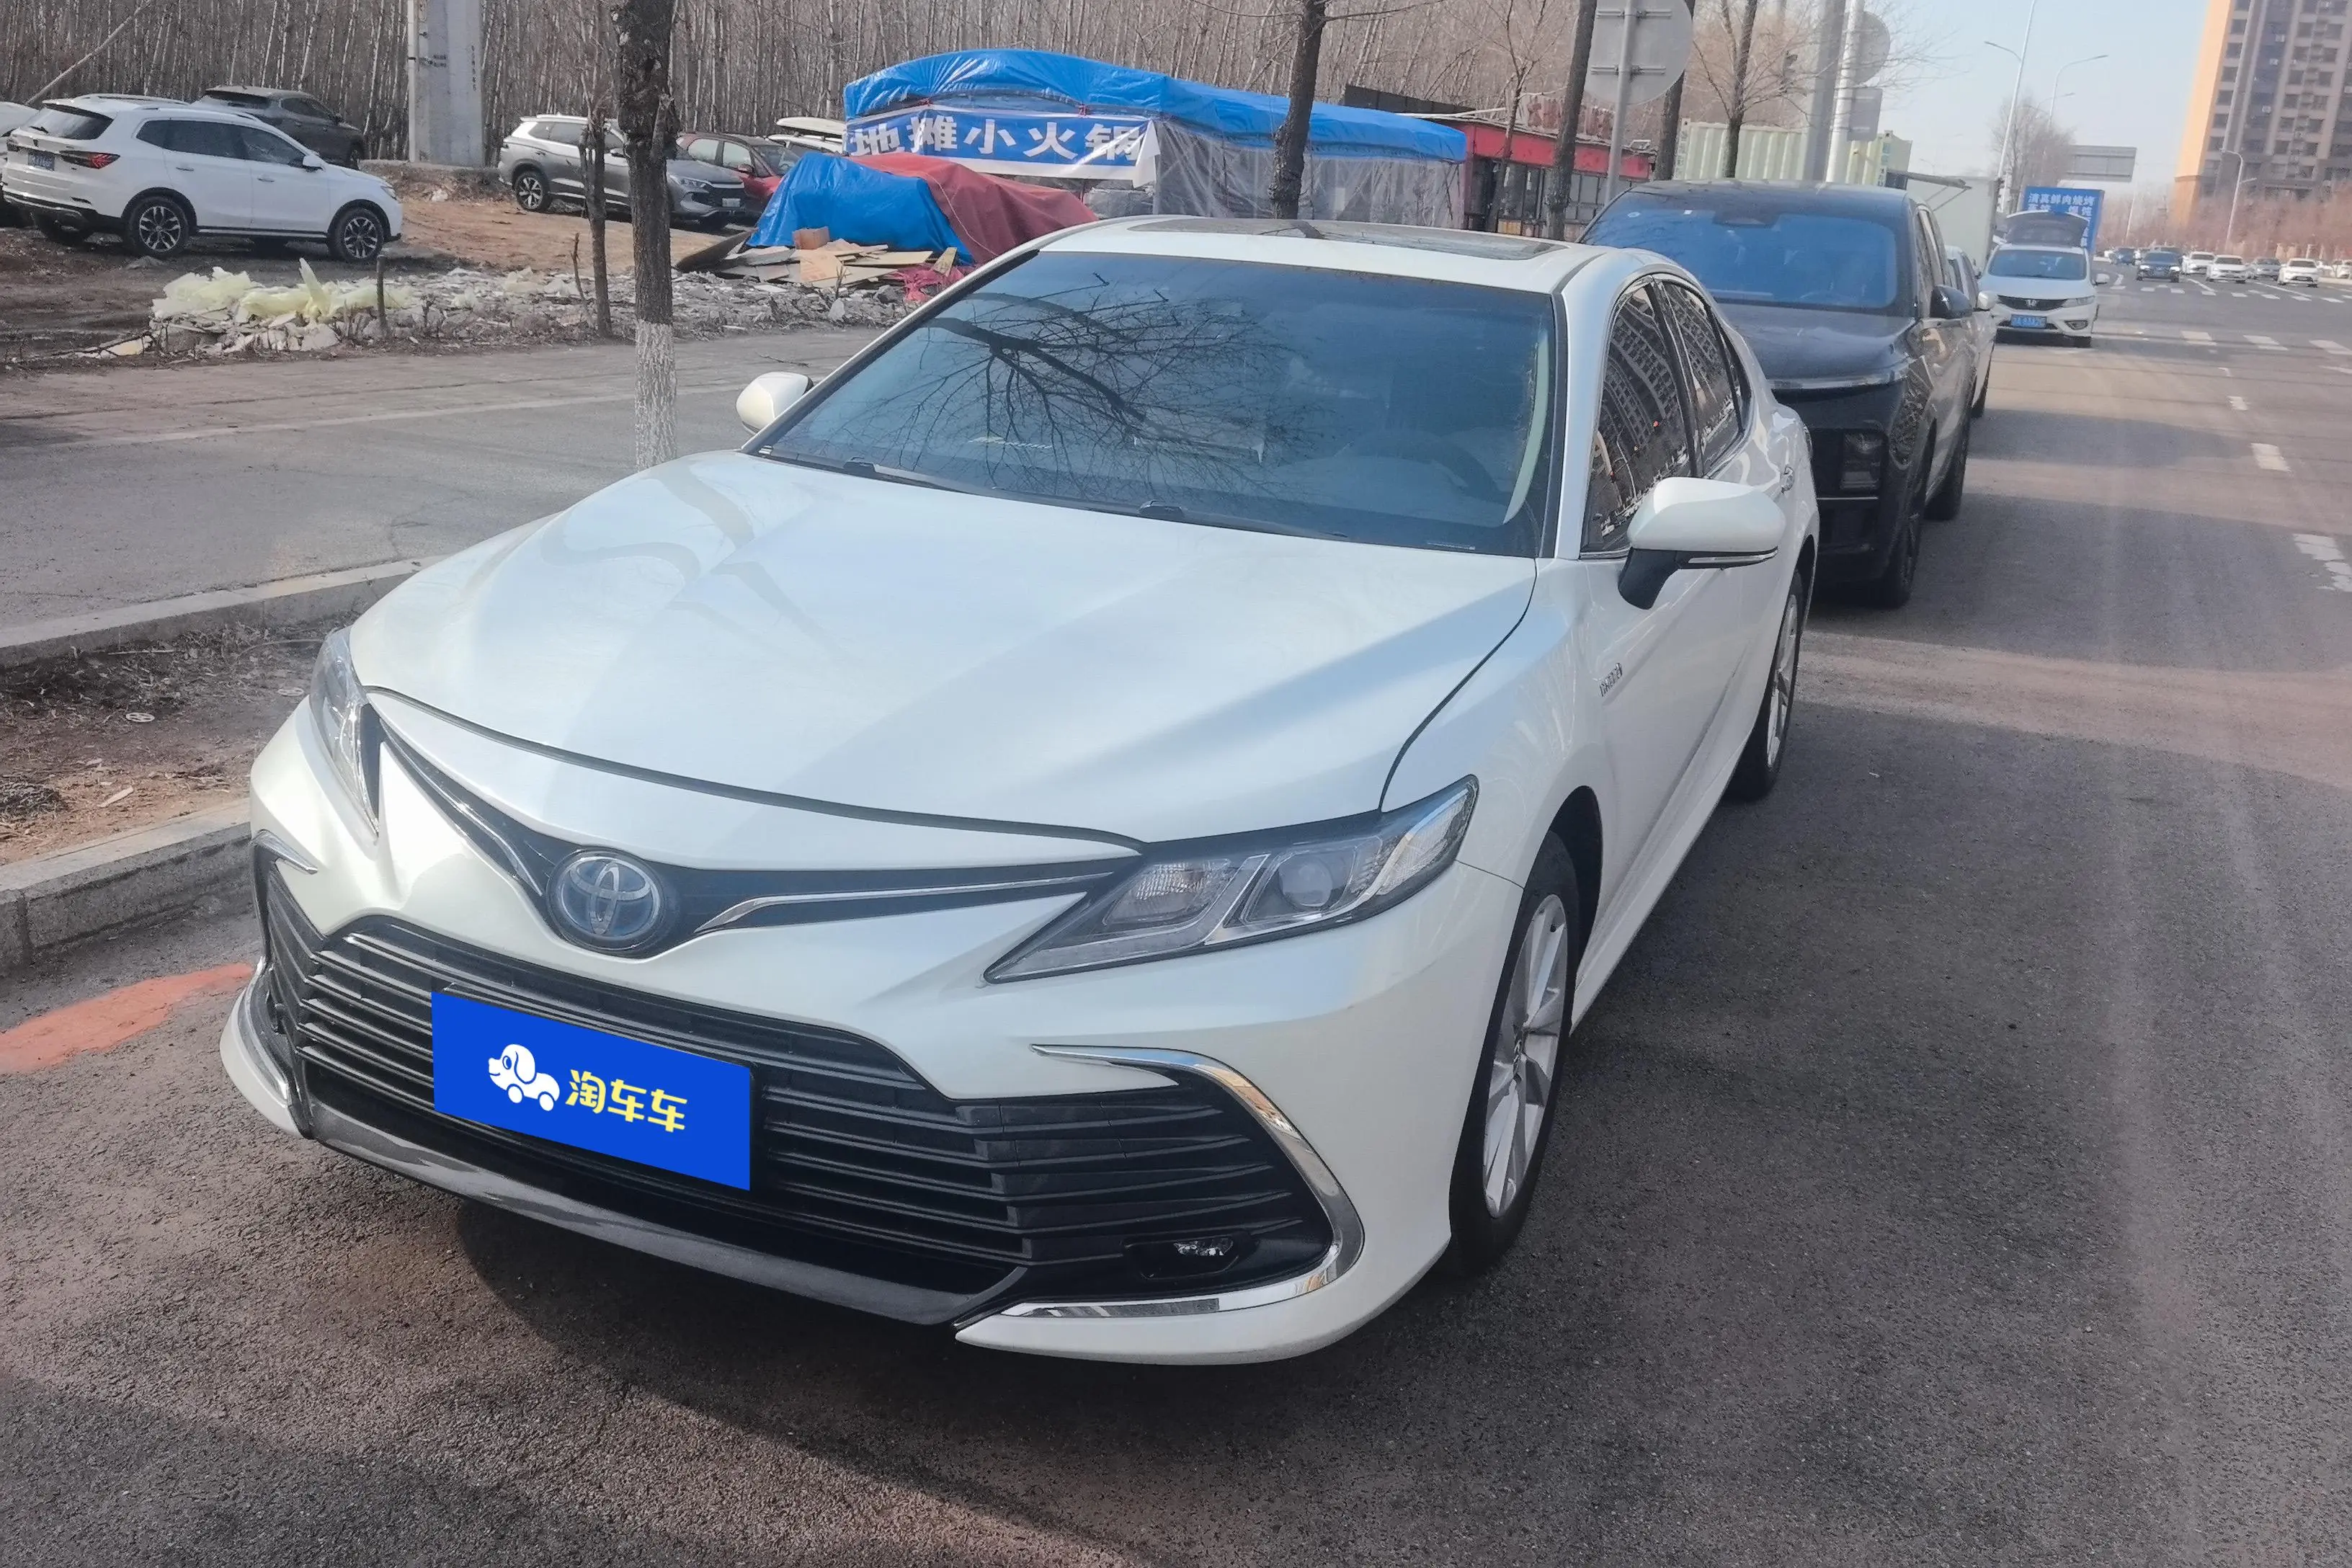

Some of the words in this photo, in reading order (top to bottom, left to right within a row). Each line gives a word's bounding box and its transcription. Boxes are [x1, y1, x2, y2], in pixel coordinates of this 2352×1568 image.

[851, 116, 1141, 160] 地摊小火锅
